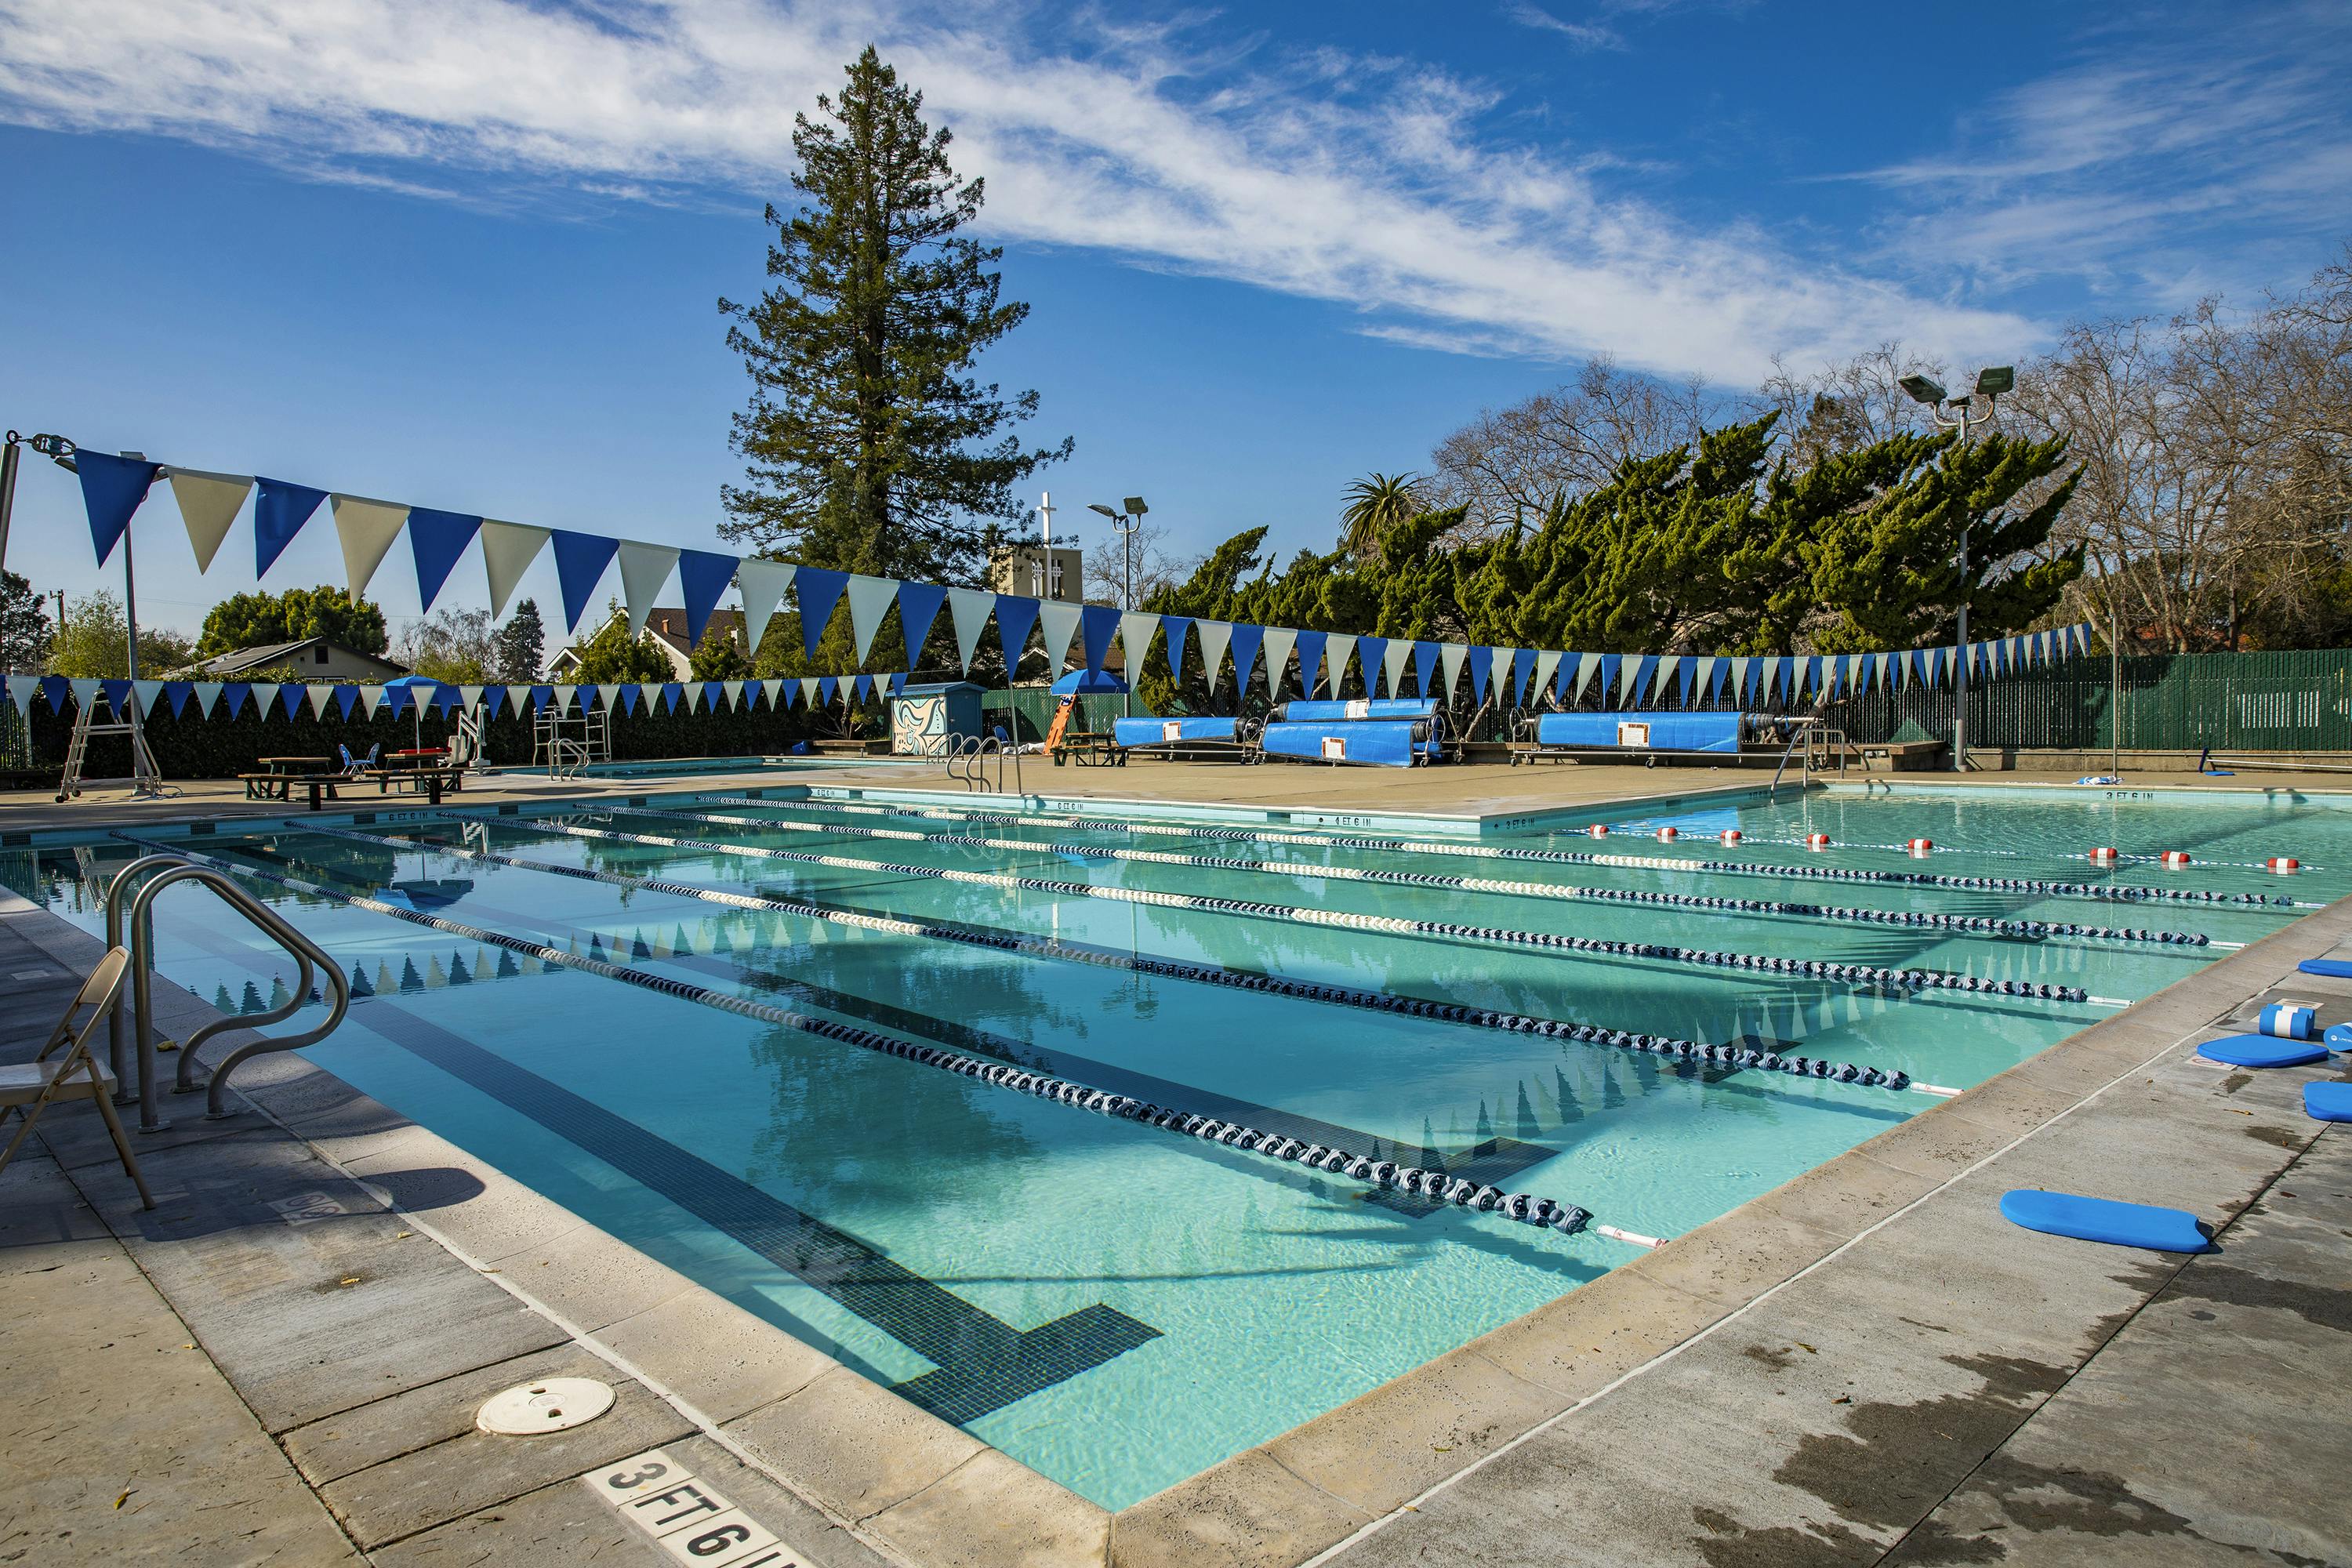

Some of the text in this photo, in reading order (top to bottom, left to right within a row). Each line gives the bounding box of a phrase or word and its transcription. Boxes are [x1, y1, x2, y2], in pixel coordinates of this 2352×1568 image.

[608, 1462, 668, 1490] 3
[633, 1483, 721, 1526] FT
[686, 1523, 752, 1557] 6
